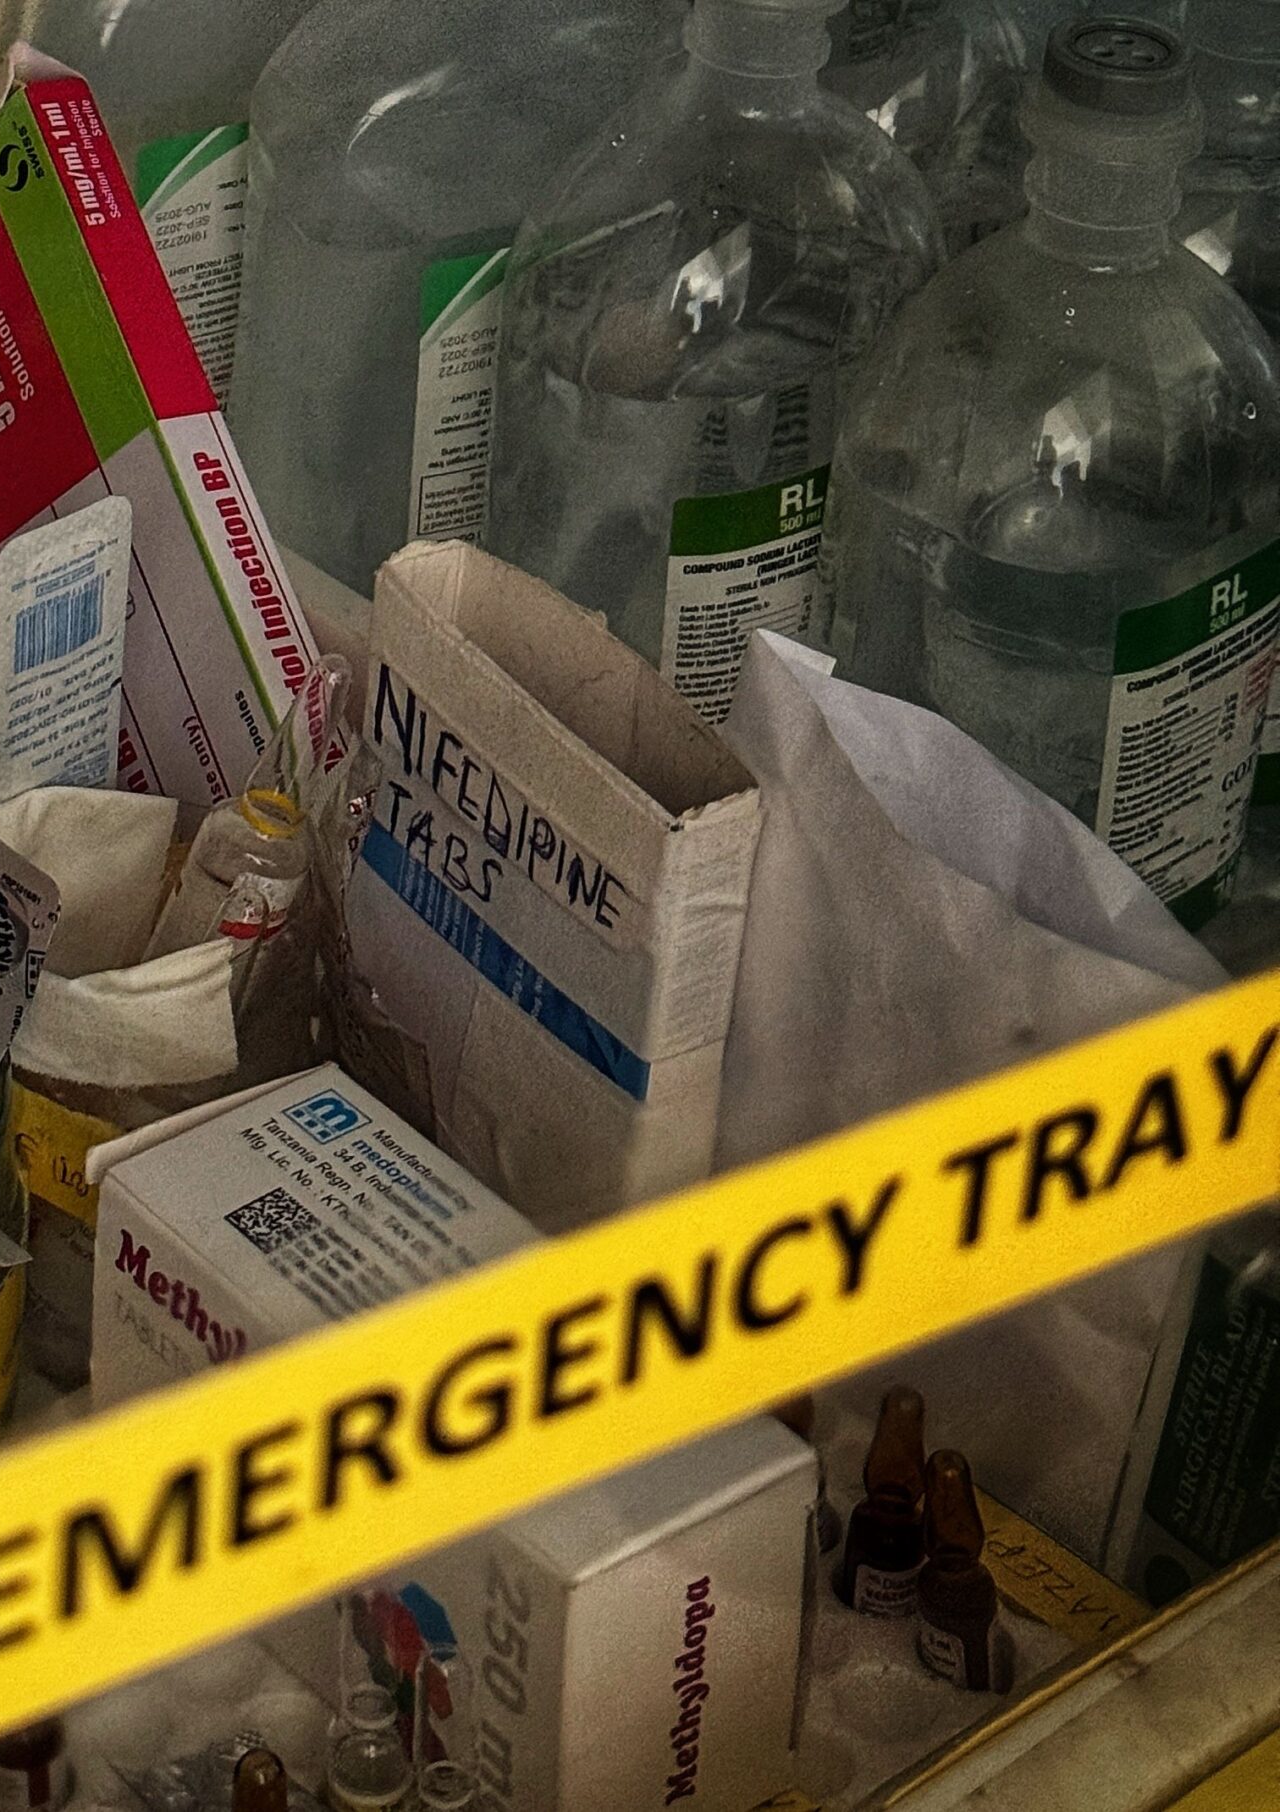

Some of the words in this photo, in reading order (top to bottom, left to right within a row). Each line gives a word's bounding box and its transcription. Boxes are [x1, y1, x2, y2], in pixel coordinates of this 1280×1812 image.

[39, 101, 68, 128] ml
[50, 129, 71, 141] 1
[56, 141, 101, 210] mg/ml,
[84, 212, 107, 227] 5
[192, 450, 232, 492] BP
[779, 478, 824, 519] RL
[780, 513, 804, 533] 500
[216, 496, 291, 641] Injection
[682, 557, 745, 576] COMPOUND
[1209, 572, 1249, 617] RL
[373, 662, 628, 929] NIFEDIPINE
[387, 781, 503, 902] TABS
[239, 1126, 268, 1153] Mfg.
[266, 1149, 292, 1172] Lic.
[290, 1167, 314, 1189] No.
[261, 1116, 318, 1165] Tanzania
[314, 1160, 353, 1196] Regn.
[333, 1147, 355, 1166] 34
[936, 1020, 1280, 1255] TRAY
[664, 1574, 715, 1806] Methyldopa
